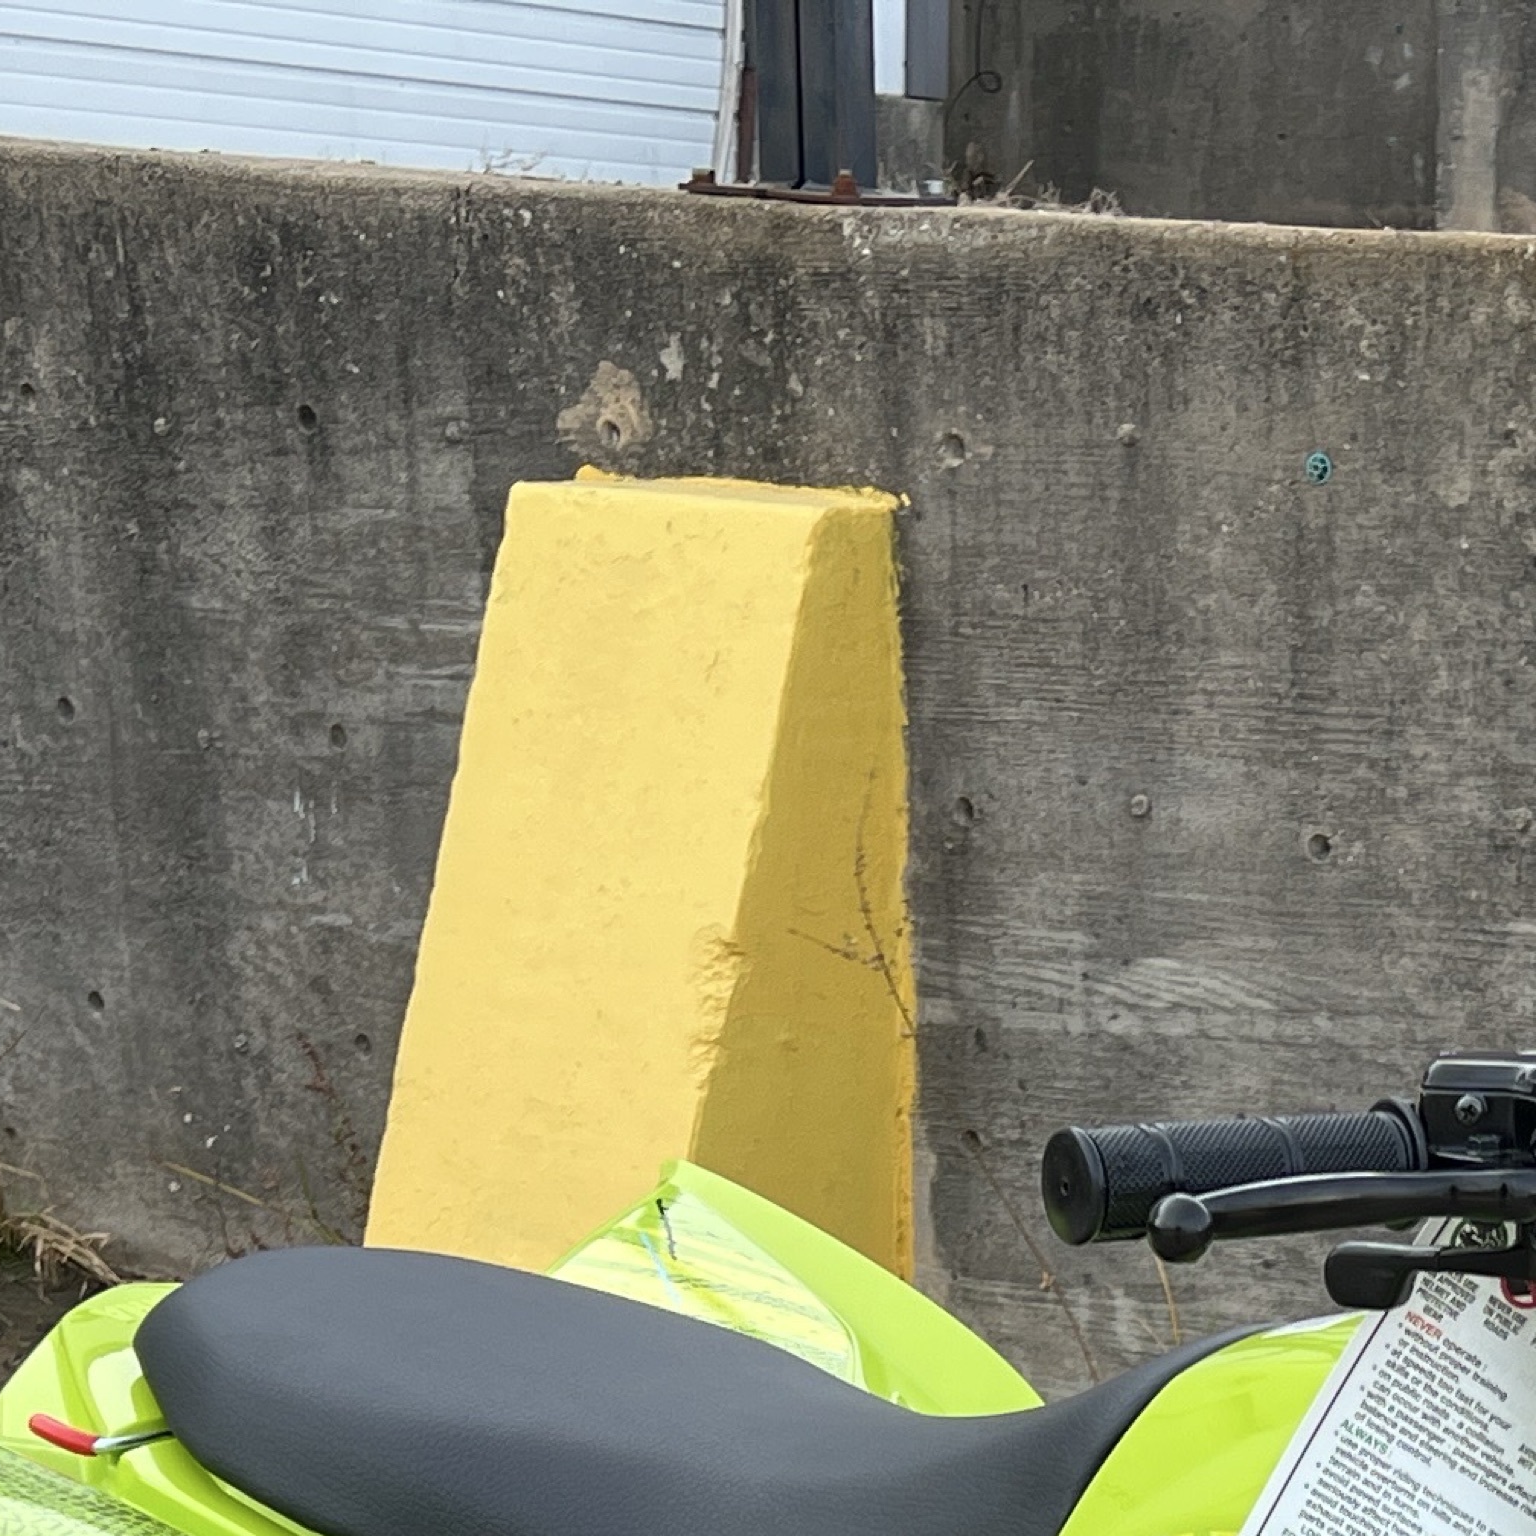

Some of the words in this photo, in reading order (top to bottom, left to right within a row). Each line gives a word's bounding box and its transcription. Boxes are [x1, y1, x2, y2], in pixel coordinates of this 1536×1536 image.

[1402, 1309, 1444, 1341] NEVER
[1383, 1356, 1411, 1379] skills
[1420, 1381, 1441, 1399] the
[1400, 1354, 1438, 1383] speeds
[1435, 1376, 1456, 1395] too
[1452, 1387, 1476, 1407] fast
[1472, 1399, 1491, 1417] for
[1486, 1411, 1512, 1433] your
[1401, 1325, 1440, 1355] without
[1437, 1350, 1472, 1377] proper
[1468, 1370, 1510, 1403] training
[1338, 1417, 1390, 1455] ALWAYS
[1363, 1417, 1397, 1445] losing
[1364, 1388, 1388, 1408] with
[1392, 1408, 1447, 1448] passenger
[1450, 1445, 1509, 1488] passengers
[1370, 1378, 1393, 1397] can
[1389, 1391, 1421, 1416] occur
[1418, 1409, 1444, 1430] with
[1441, 1423, 1480, 1454] another
[1376, 1368, 1393, 1382] on
[1389, 1375, 1424, 1403] public
[1420, 1396, 1452, 1421] roads
[1463, 1423, 1507, 1457] collision
[1326, 1454, 1363, 1482] terrain
[1360, 1475, 1383, 1495] and
[1333, 1444, 1370, 1472] vehicle
[1368, 1466, 1418, 1503] overturns
[1414, 1496, 1432, 1512] on
[1429, 1505, 1453, 1525] hills
[1338, 1433, 1360, 1452] use
[1357, 1446, 1392, 1474] proper
[1390, 1466, 1423, 1494] riding
[1419, 1484, 1477, 1527] techniques
[1358, 1398, 1400, 1430] balance
[1397, 1423, 1420, 1444] and
[1415, 1437, 1460, 1472] steering
[1456, 1462, 1479, 1482] and
[1476, 1475, 1521, 1509] increase
[1296, 1507, 1327, 1532] parts
[1303, 1496, 1346, 1528] exhaust
[1308, 1486, 1339, 1511] avoid
[1314, 1475, 1362, 1512] seriously
[1359, 1503, 1392, 1529] affect
[1320, 1464, 1351, 1489] avoid
[1347, 1481, 1382, 1510] paved
[1378, 1500, 1425, 1536] surfaces
